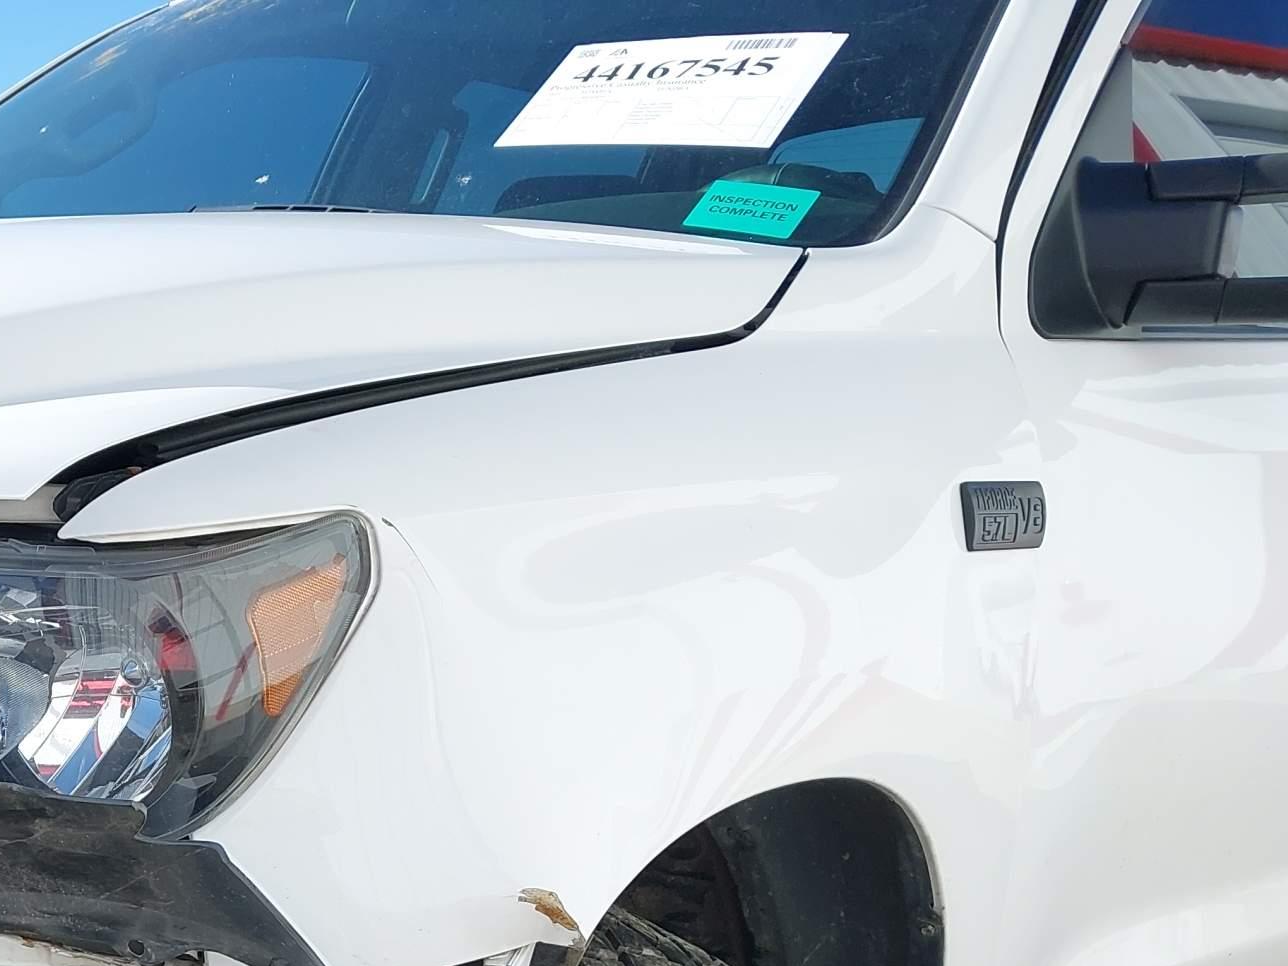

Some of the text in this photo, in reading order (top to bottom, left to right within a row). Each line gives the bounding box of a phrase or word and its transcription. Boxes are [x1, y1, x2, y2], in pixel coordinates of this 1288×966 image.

[573, 56, 781, 82] 44167545
[711, 194, 798, 212] INSPECTION
[709, 205, 789, 222] COMPLETE
